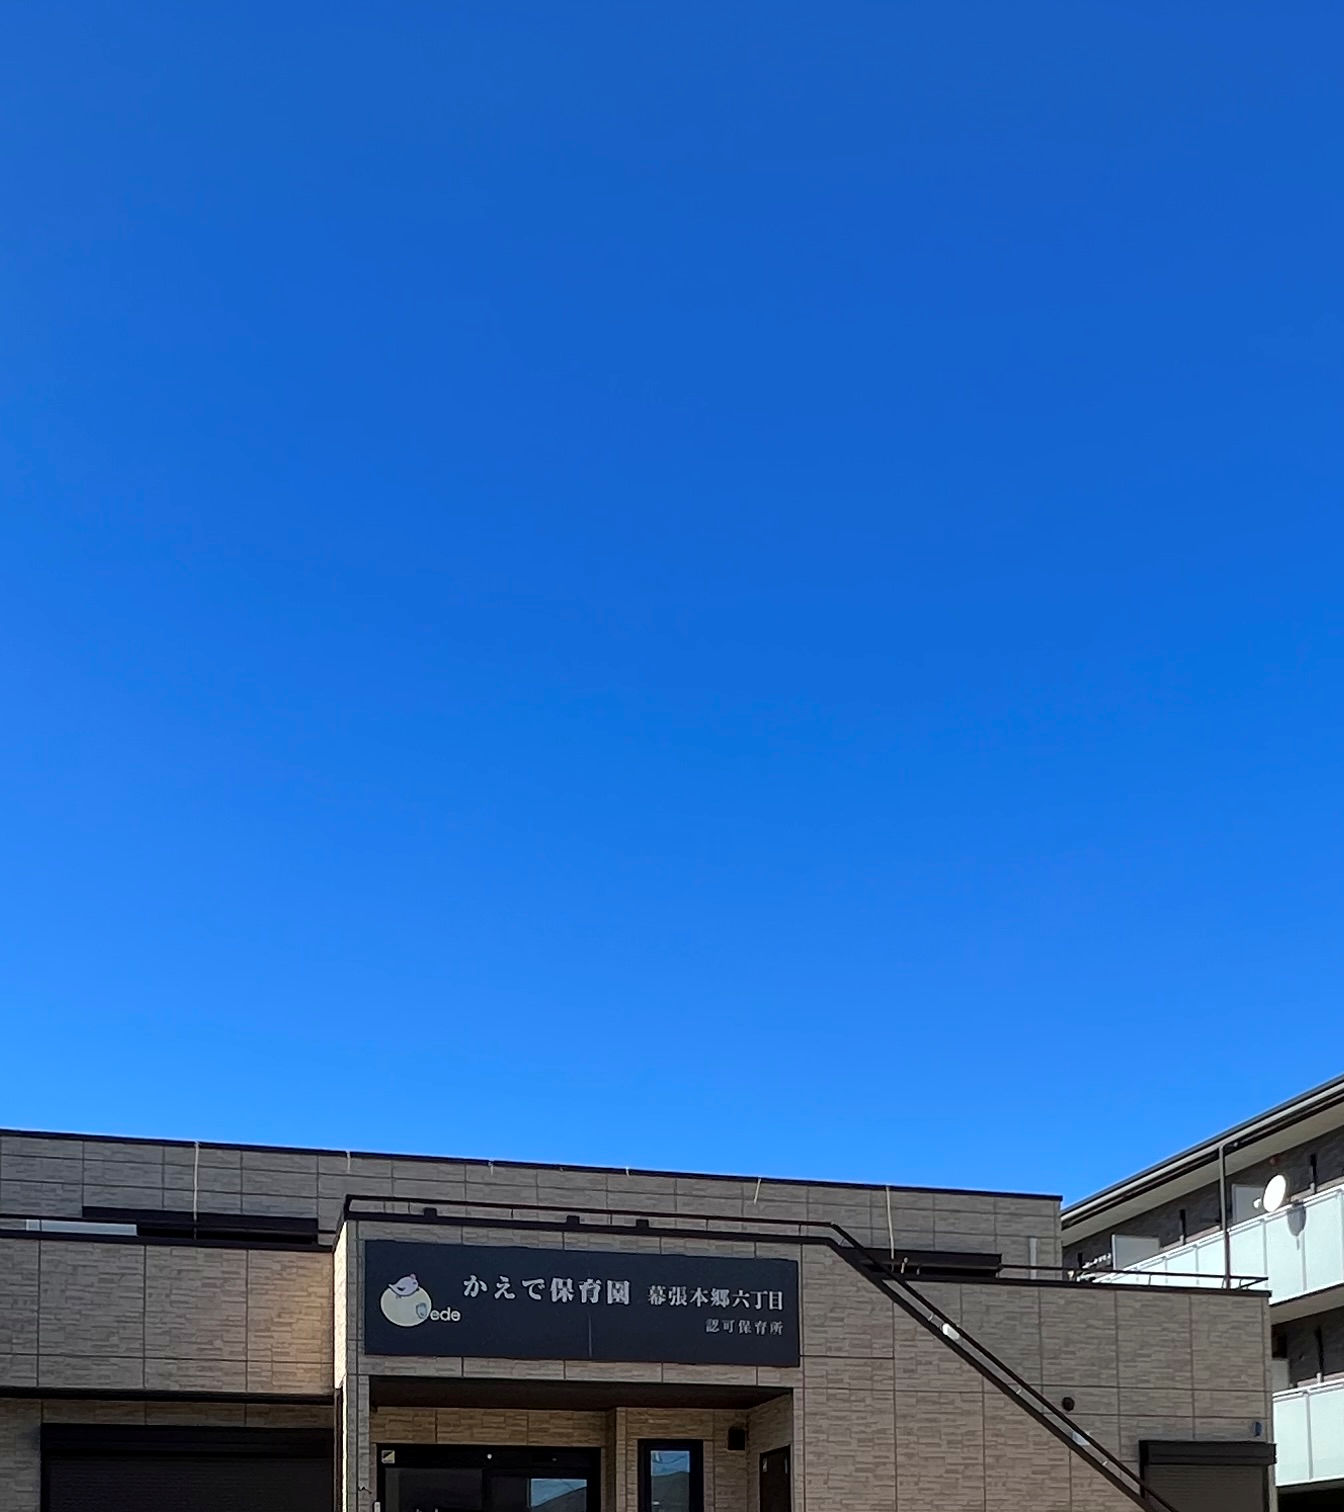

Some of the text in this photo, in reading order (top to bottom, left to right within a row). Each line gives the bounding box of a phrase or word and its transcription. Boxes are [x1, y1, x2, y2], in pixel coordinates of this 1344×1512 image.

[463, 1275, 784, 1311] かえで保育園 幕張本郷六丁目
[706, 1318, 784, 1336] 認可保育所
